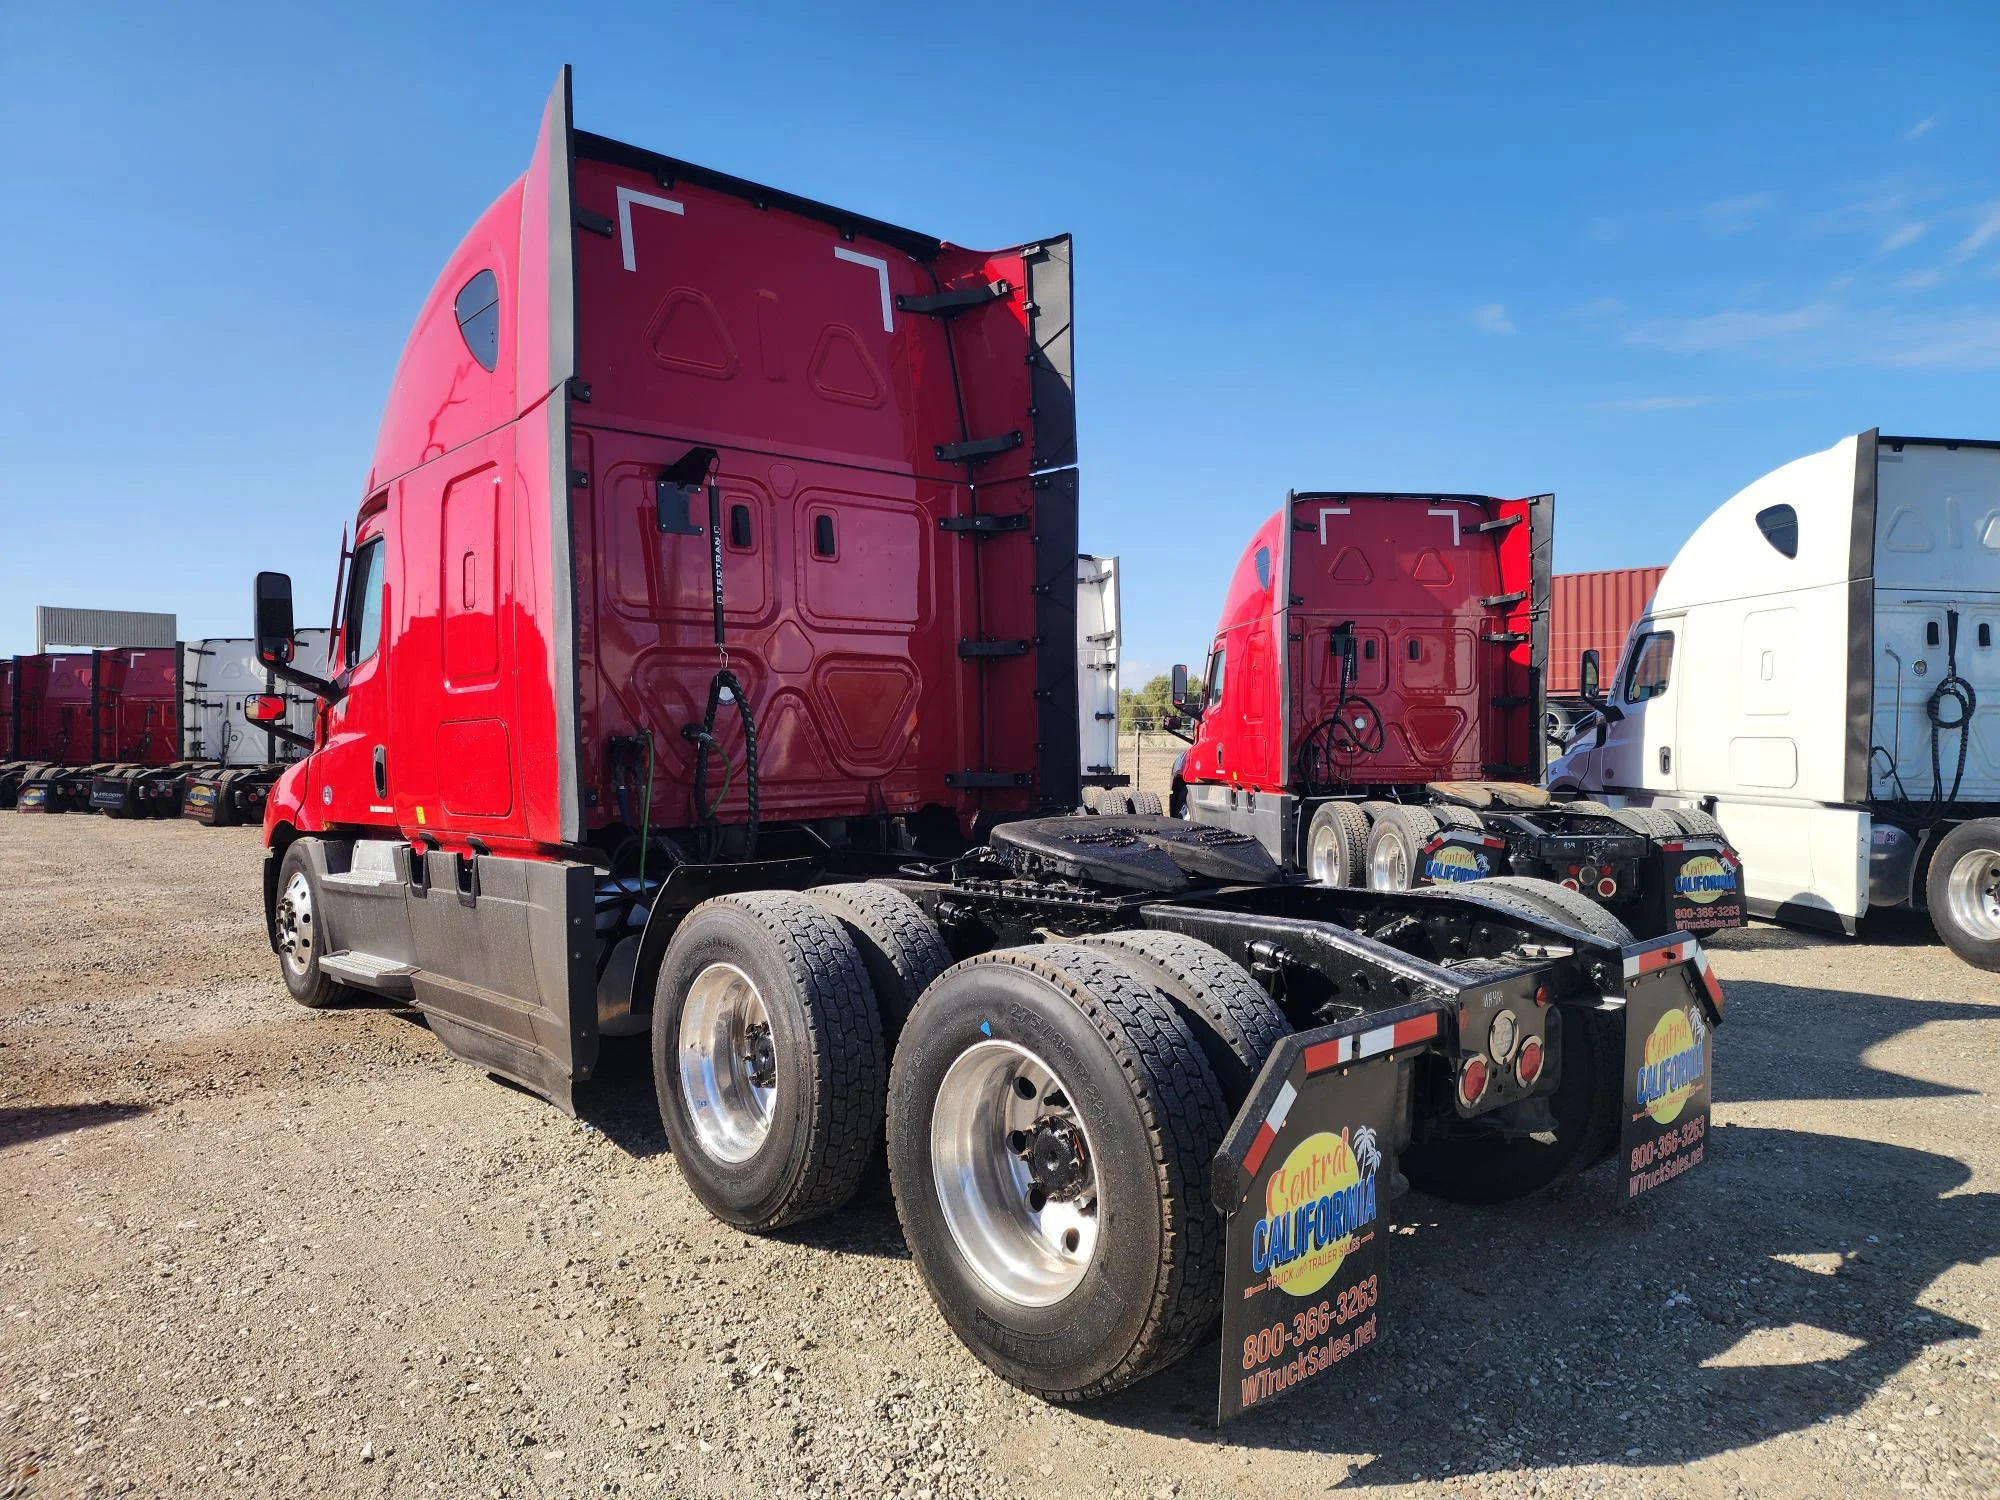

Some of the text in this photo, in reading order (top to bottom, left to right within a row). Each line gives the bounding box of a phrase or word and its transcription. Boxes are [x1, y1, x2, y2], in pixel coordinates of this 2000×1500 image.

[715, 537, 723, 592] TECTRAN
[1674, 870, 1737, 892] CALIFORNIA
[1675, 905, 1740, 919] 800-366-3263
[1676, 918, 1741, 929] WTruckSales.net
[1645, 1005, 1688, 1066] Central
[1637, 1043, 1704, 1104] CALIFORNIA
[1266, 1126, 1349, 1216] Central
[1629, 1141, 1704, 1198] WTruckSales.net
[1631, 1114, 1704, 1172] 800-366-3263
[1252, 1175, 1376, 1273] CALIFORNIA
[1266, 1268, 1294, 1291] TRUCK
[1308, 1252, 1337, 1272] TRAILER
[1339, 1237, 1361, 1258] SALES
[1242, 1274, 1377, 1370] 800-366-3263
[1241, 1312, 1377, 1407] WTruckSales.net
